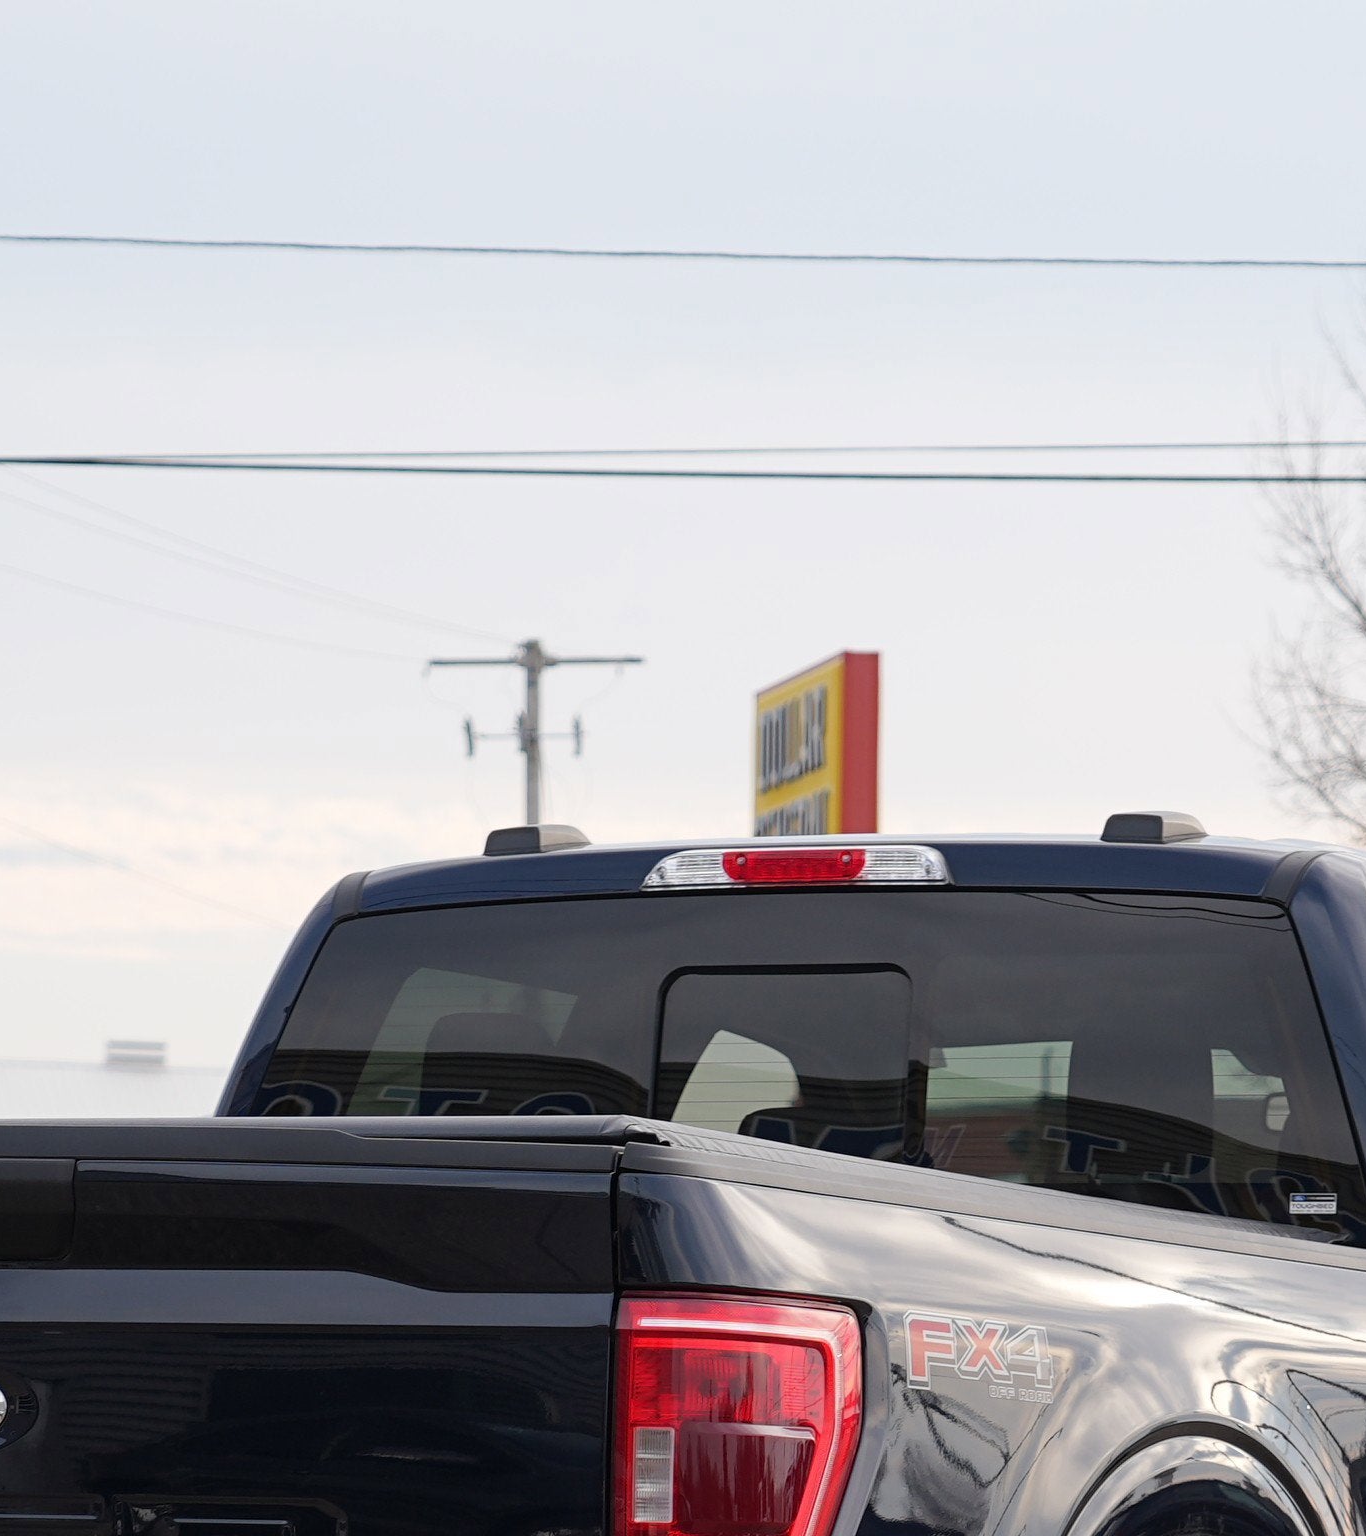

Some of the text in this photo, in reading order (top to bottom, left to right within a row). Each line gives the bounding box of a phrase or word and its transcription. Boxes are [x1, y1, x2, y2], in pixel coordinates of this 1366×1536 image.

[903, 1309, 1054, 1391] FX4
[988, 1385, 1054, 1404] OFF ROAD
